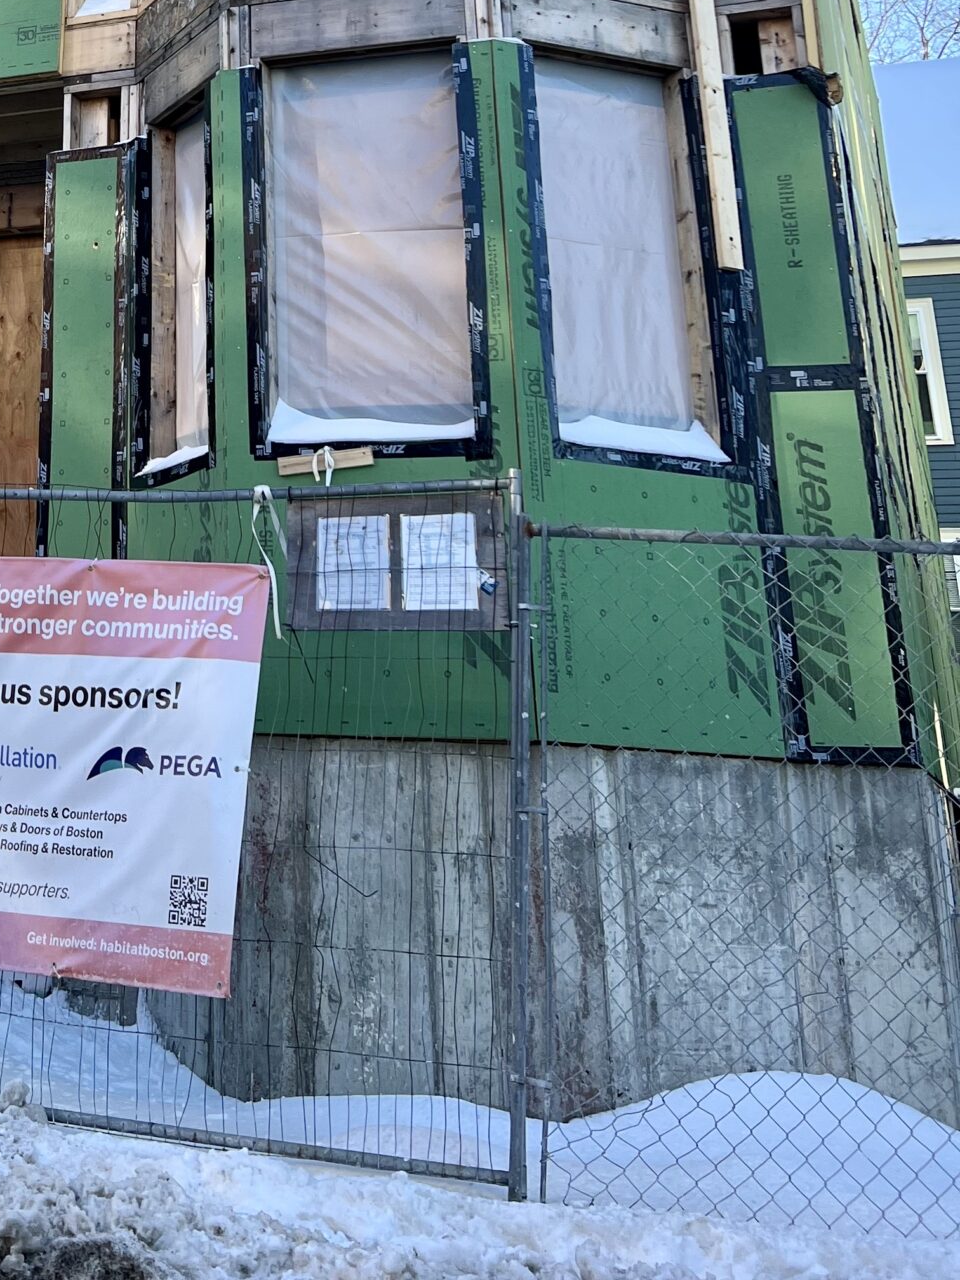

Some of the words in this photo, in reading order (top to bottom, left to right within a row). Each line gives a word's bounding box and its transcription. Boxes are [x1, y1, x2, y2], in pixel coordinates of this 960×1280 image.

[777, 173, 804, 269] R-SHEATHING
[151, 588, 244, 614] building
[81, 616, 239, 641] communities.
[38, 681, 182, 713] sponsors!
[158, 754, 223, 779] PEGA
[4, 803, 50, 818] Cabinets
[50, 806, 59, 819] &
[61, 807, 128, 823] Countertops
[10, 821, 18, 833] &
[20, 823, 52, 836] Doors
[53, 825, 65, 837] of
[65, 827, 104, 840] Boston
[0, 839, 39, 855] Roofing
[41, 842, 49, 854] &
[51, 843, 114, 859] Restoration
[27, 931, 48, 947] Get
[48, 932, 98, 951] involved:
[99, 940, 209, 966] habitatboston.org
